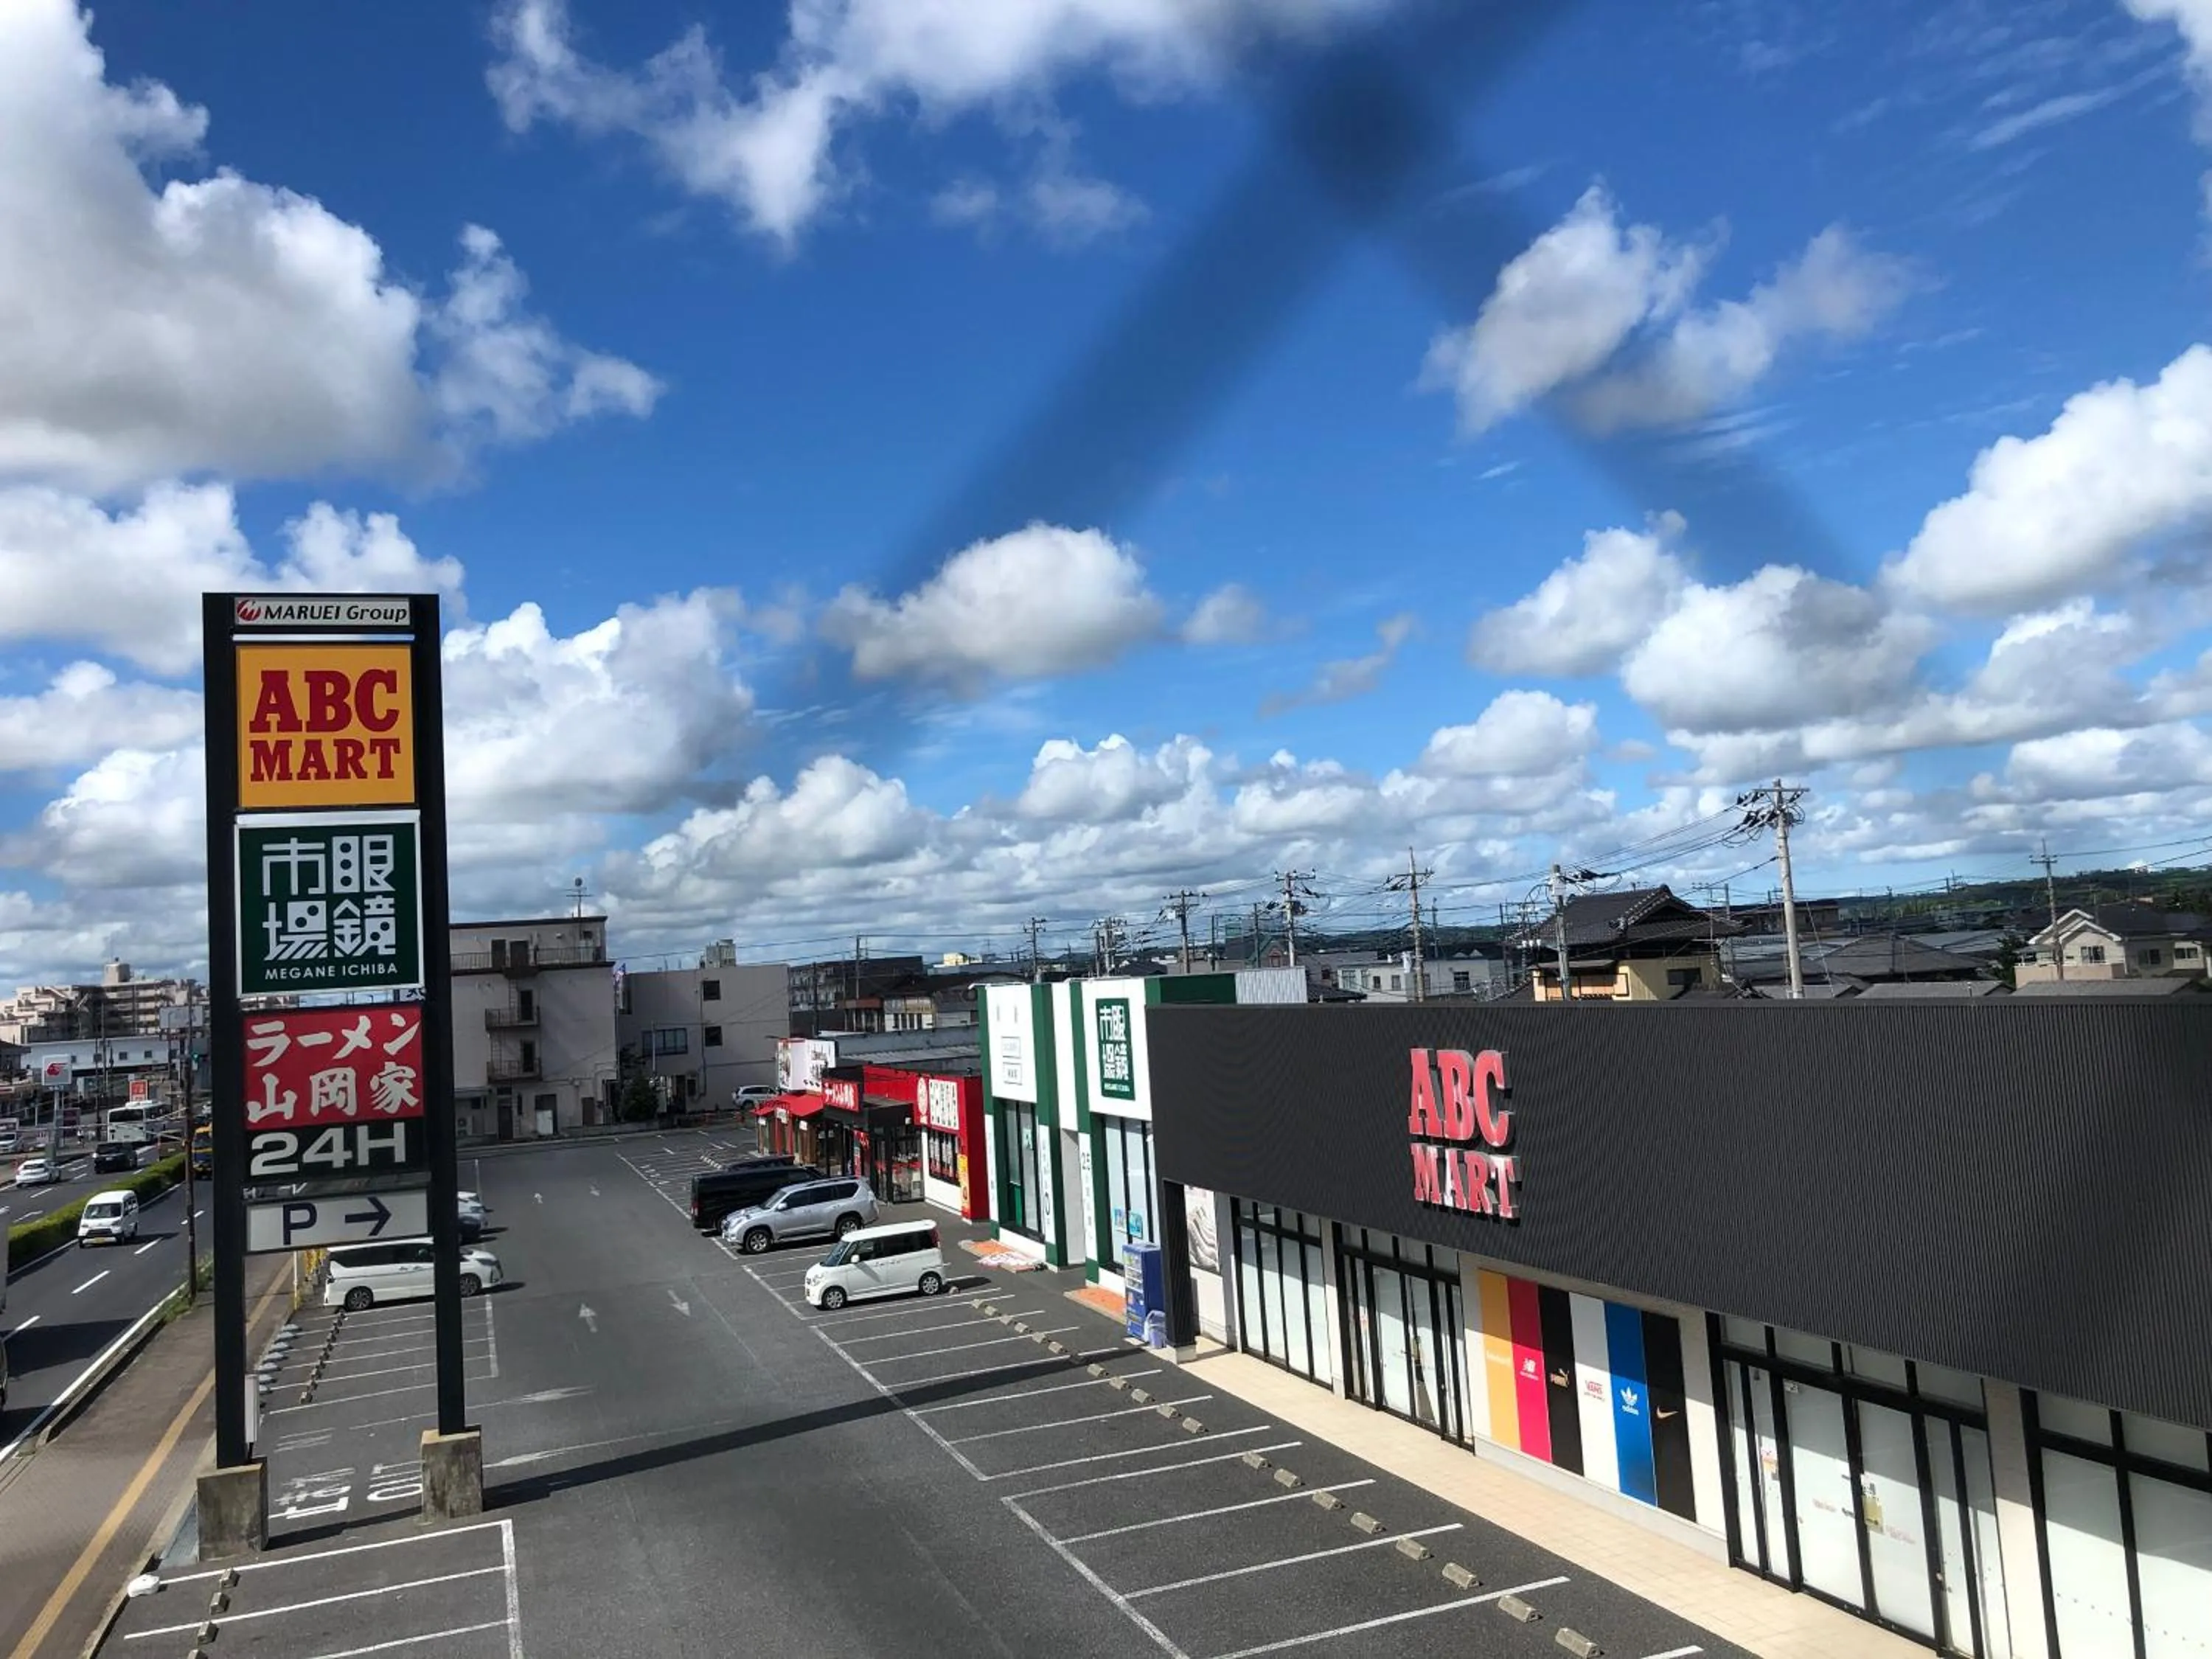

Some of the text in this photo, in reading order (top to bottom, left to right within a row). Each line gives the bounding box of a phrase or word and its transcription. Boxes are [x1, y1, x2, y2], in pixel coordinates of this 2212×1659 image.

[264, 605, 407, 623] MARUEI Group
[249, 669, 400, 734] ABC
[249, 738, 400, 782] MART
[265, 963, 399, 980] MEGANE ICHIBA
[247, 1013, 420, 1067] ラーメン
[247, 1062, 420, 1122] 山岡家
[1408, 1047, 1512, 1147] ABC
[250, 1121, 406, 1176] 24H
[1410, 1142, 1520, 1220] MART
[282, 1202, 318, 1245] P
